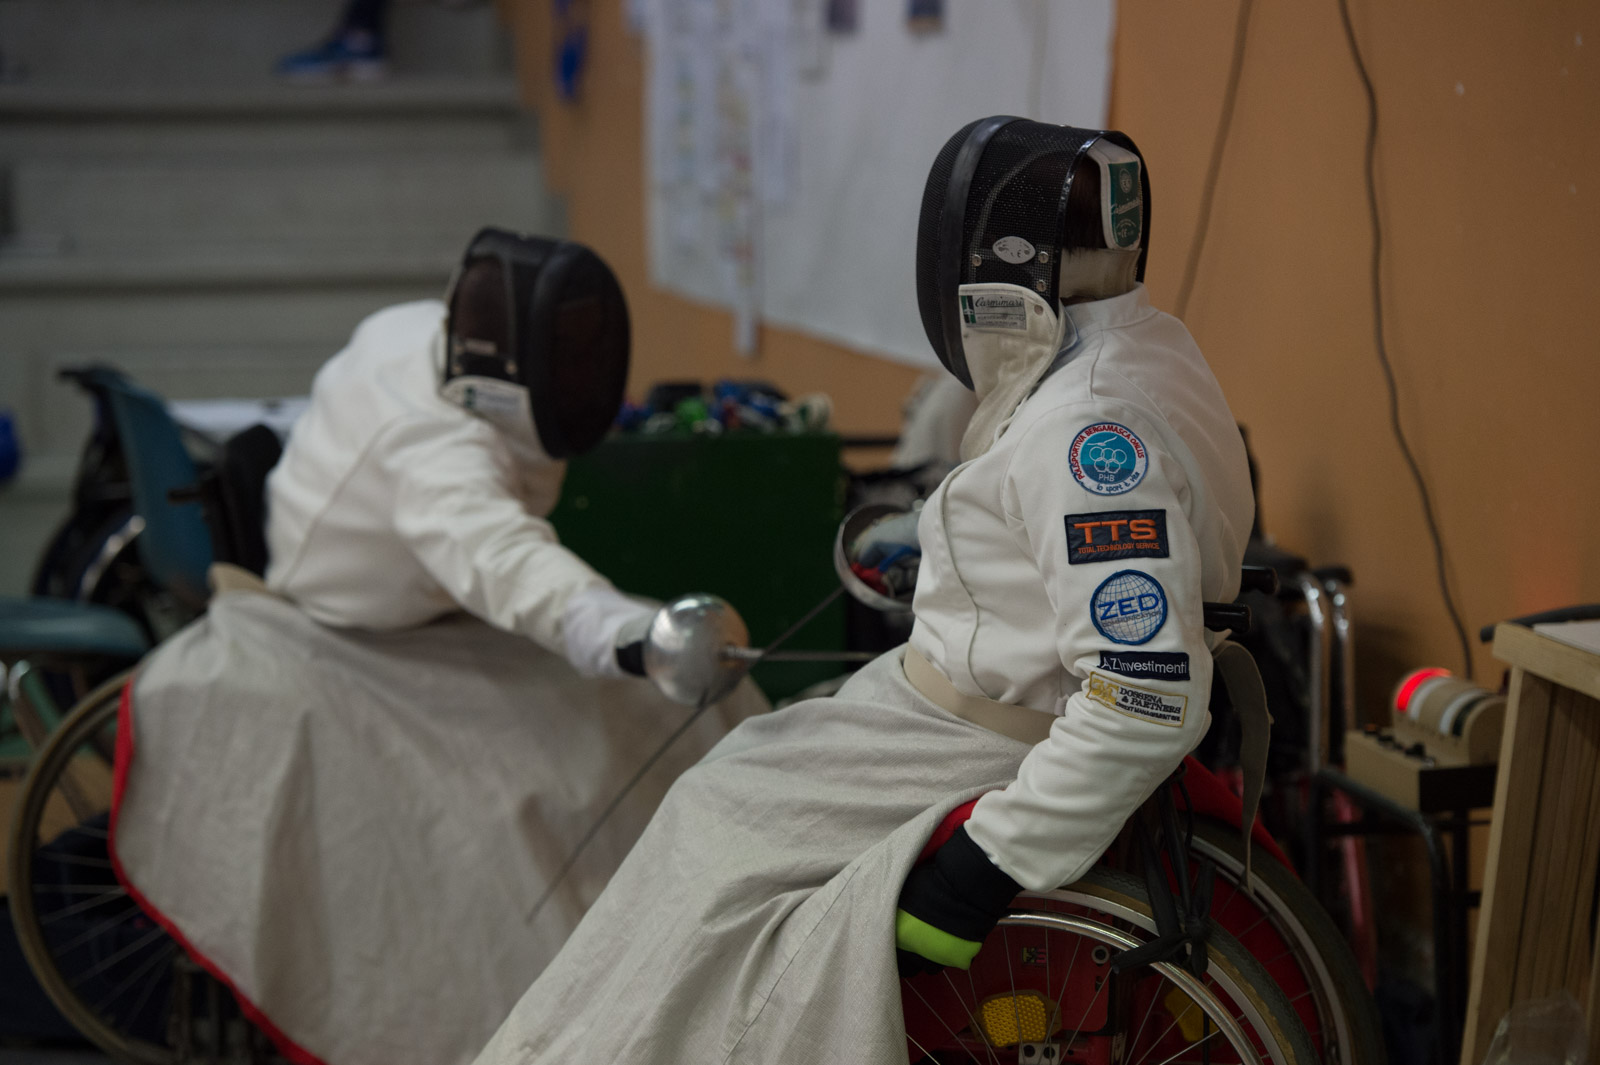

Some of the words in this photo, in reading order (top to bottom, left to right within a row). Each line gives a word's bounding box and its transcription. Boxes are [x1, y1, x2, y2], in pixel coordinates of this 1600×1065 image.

[1084, 424, 1130, 440] BERGAMASCA
[1130, 438, 1145, 459] ONLUS
[1098, 473, 1115, 482] PHB
[1106, 486, 1124, 494] sport
[1073, 519, 1158, 544] TTS
[1078, 546, 1097, 554] TOTAL
[1096, 543, 1135, 553] TECHNOLOGY
[1136, 542, 1160, 550] SERVICE
[1098, 593, 1159, 620] ZED
[1119, 687, 1162, 704] DOSSENA
[1130, 697, 1181, 714] PARTNERS
